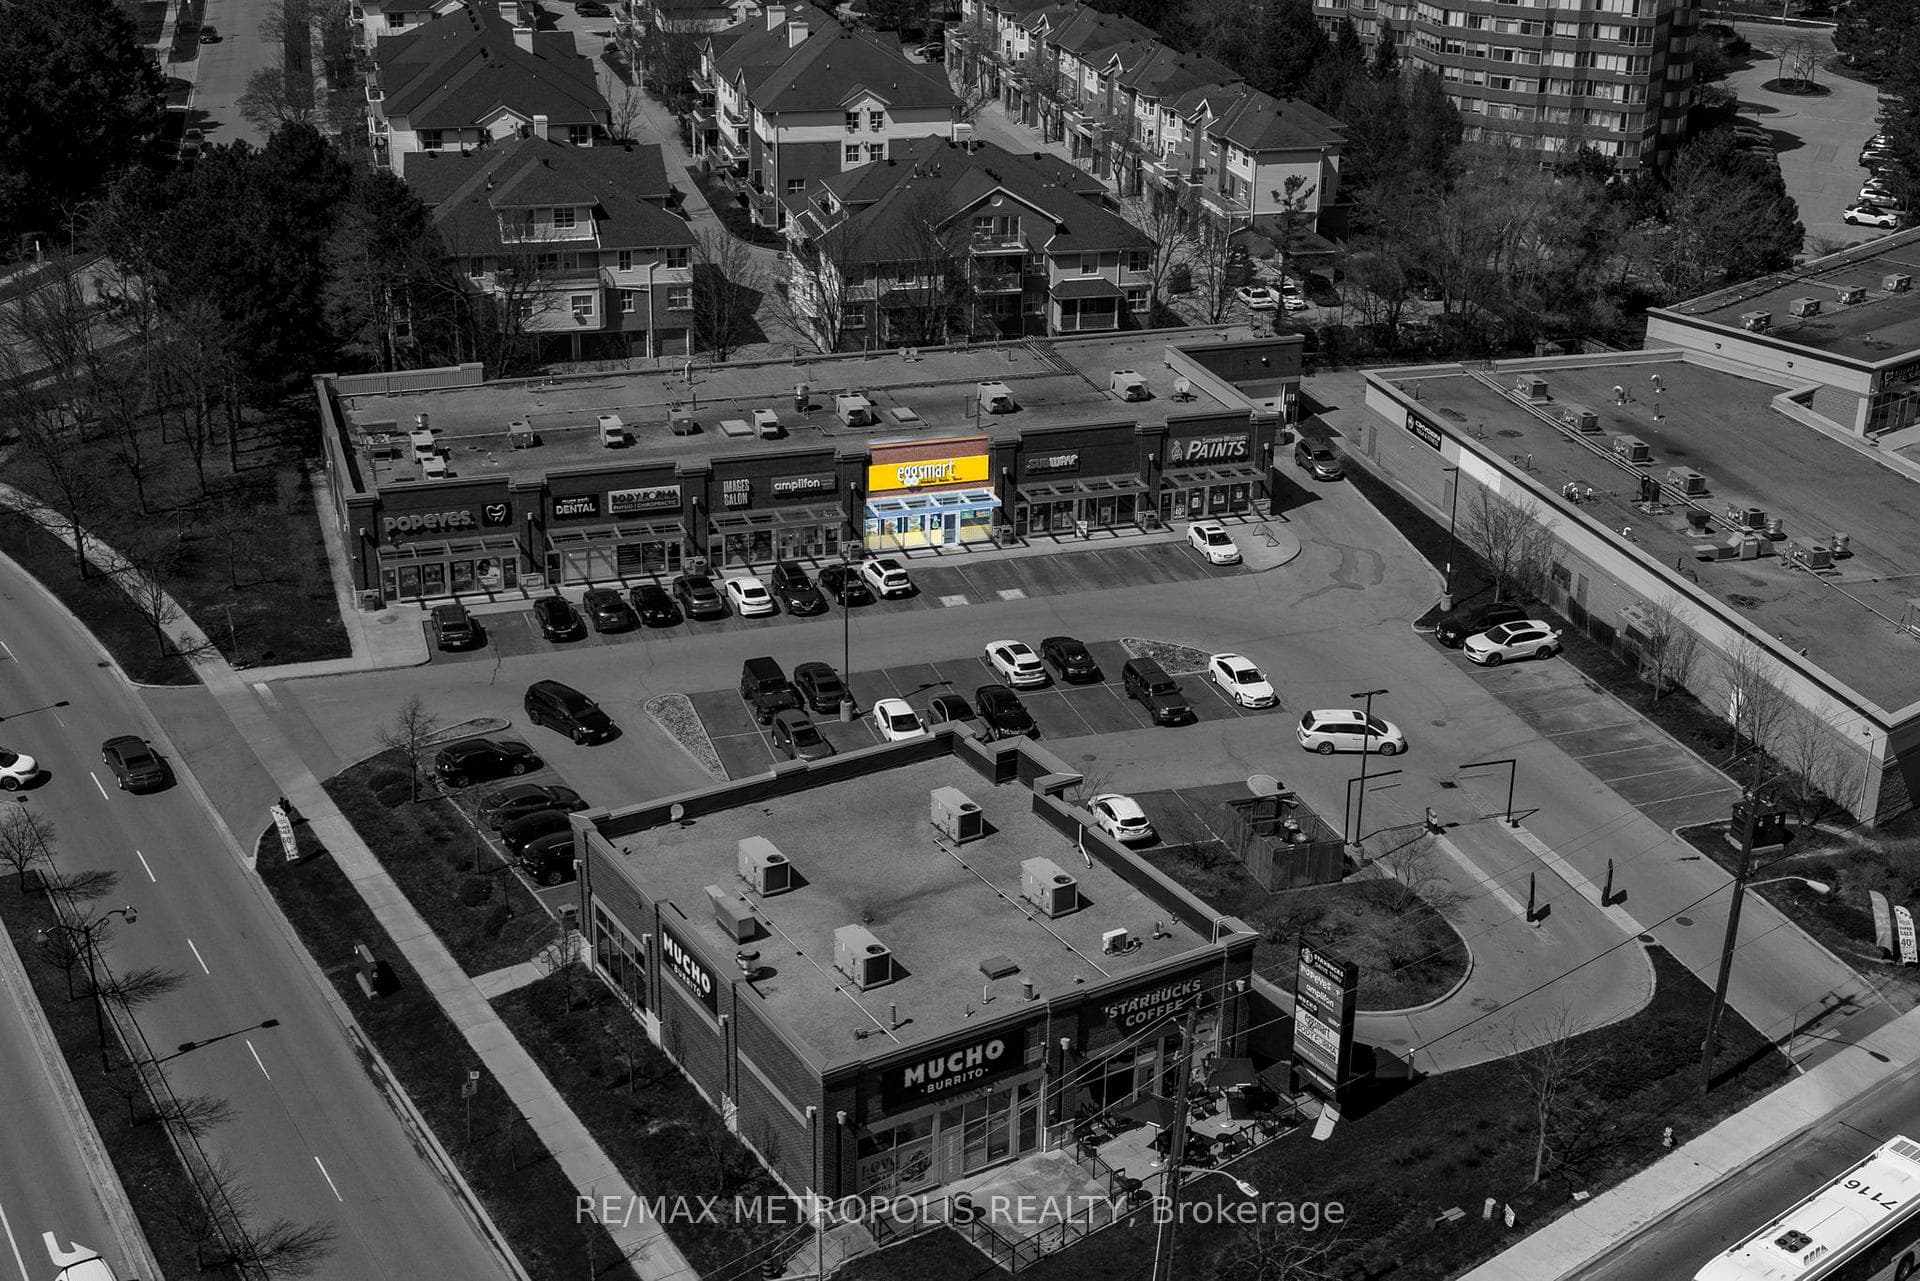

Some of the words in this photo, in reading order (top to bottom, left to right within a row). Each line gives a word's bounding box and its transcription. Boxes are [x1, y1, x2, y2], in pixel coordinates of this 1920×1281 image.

[1186, 439, 1247, 460] PAINTS
[897, 461, 956, 482] eggsmart
[1026, 454, 1079, 469] SUBWAY
[611, 492, 641, 503] BODY
[642, 489, 678, 501] FORMA
[723, 478, 750, 493] IMAGES
[774, 478, 821, 491] amplifon
[555, 502, 597, 515] DENTAL
[723, 492, 749, 506] SALON
[663, 931, 712, 994] MUCHO
[1314, 953, 1344, 978] STARBUCKS
[1108, 979, 1201, 1019] STARBUCKS
[1306, 983, 1335, 1008] amplifon
[1125, 999, 1184, 1027] COFFEE
[904, 1039, 1006, 1089] MUCHO
[926, 1067, 984, 1094] BURRITO
[1843, 1179, 1899, 1211] 7116
